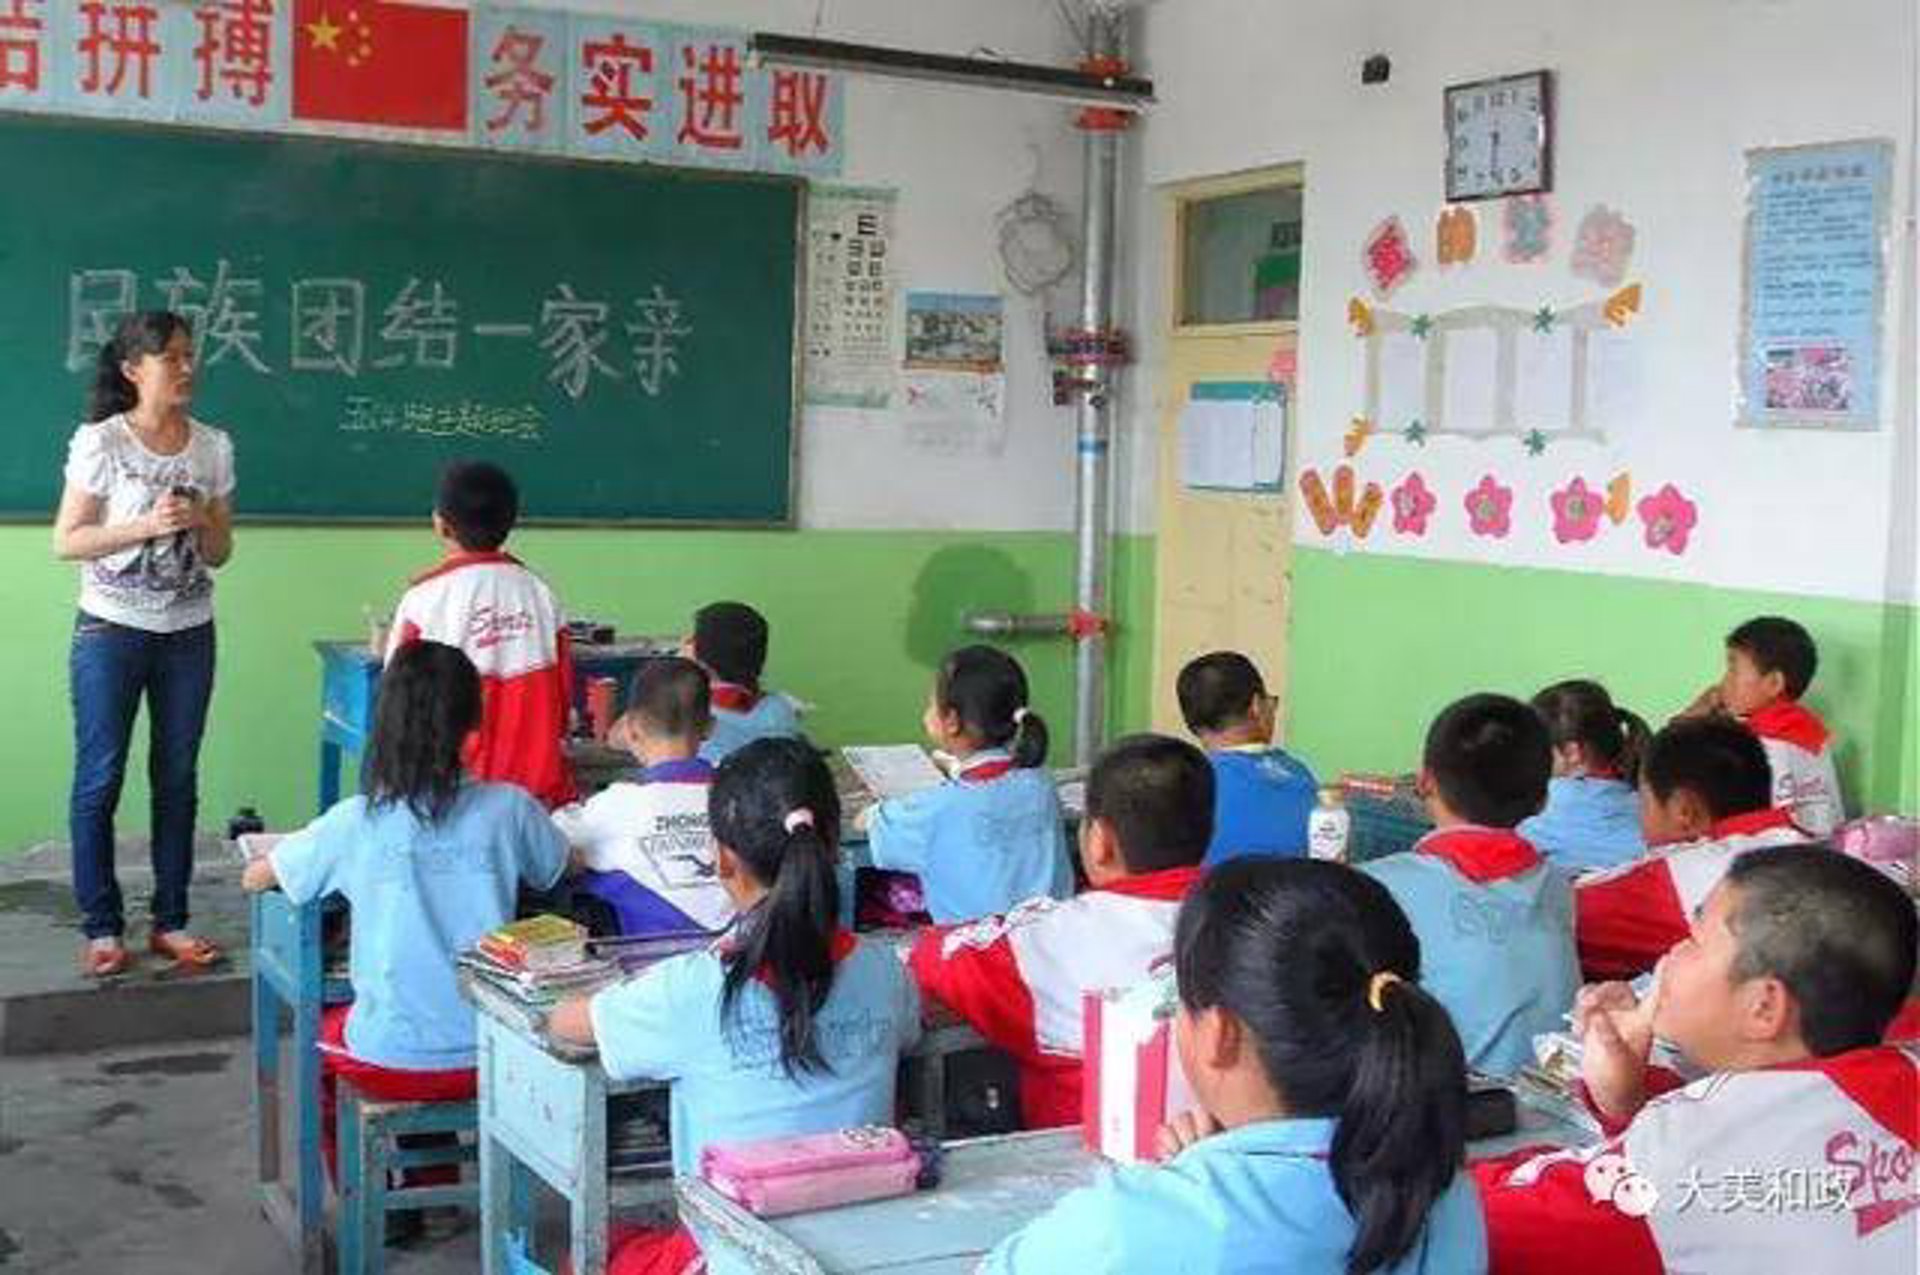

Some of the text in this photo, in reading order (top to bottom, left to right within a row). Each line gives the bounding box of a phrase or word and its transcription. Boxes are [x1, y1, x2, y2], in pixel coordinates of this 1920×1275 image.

[484, 25, 829, 156] 务实进取
[65, 259, 693, 399] 民族团结一家亲
